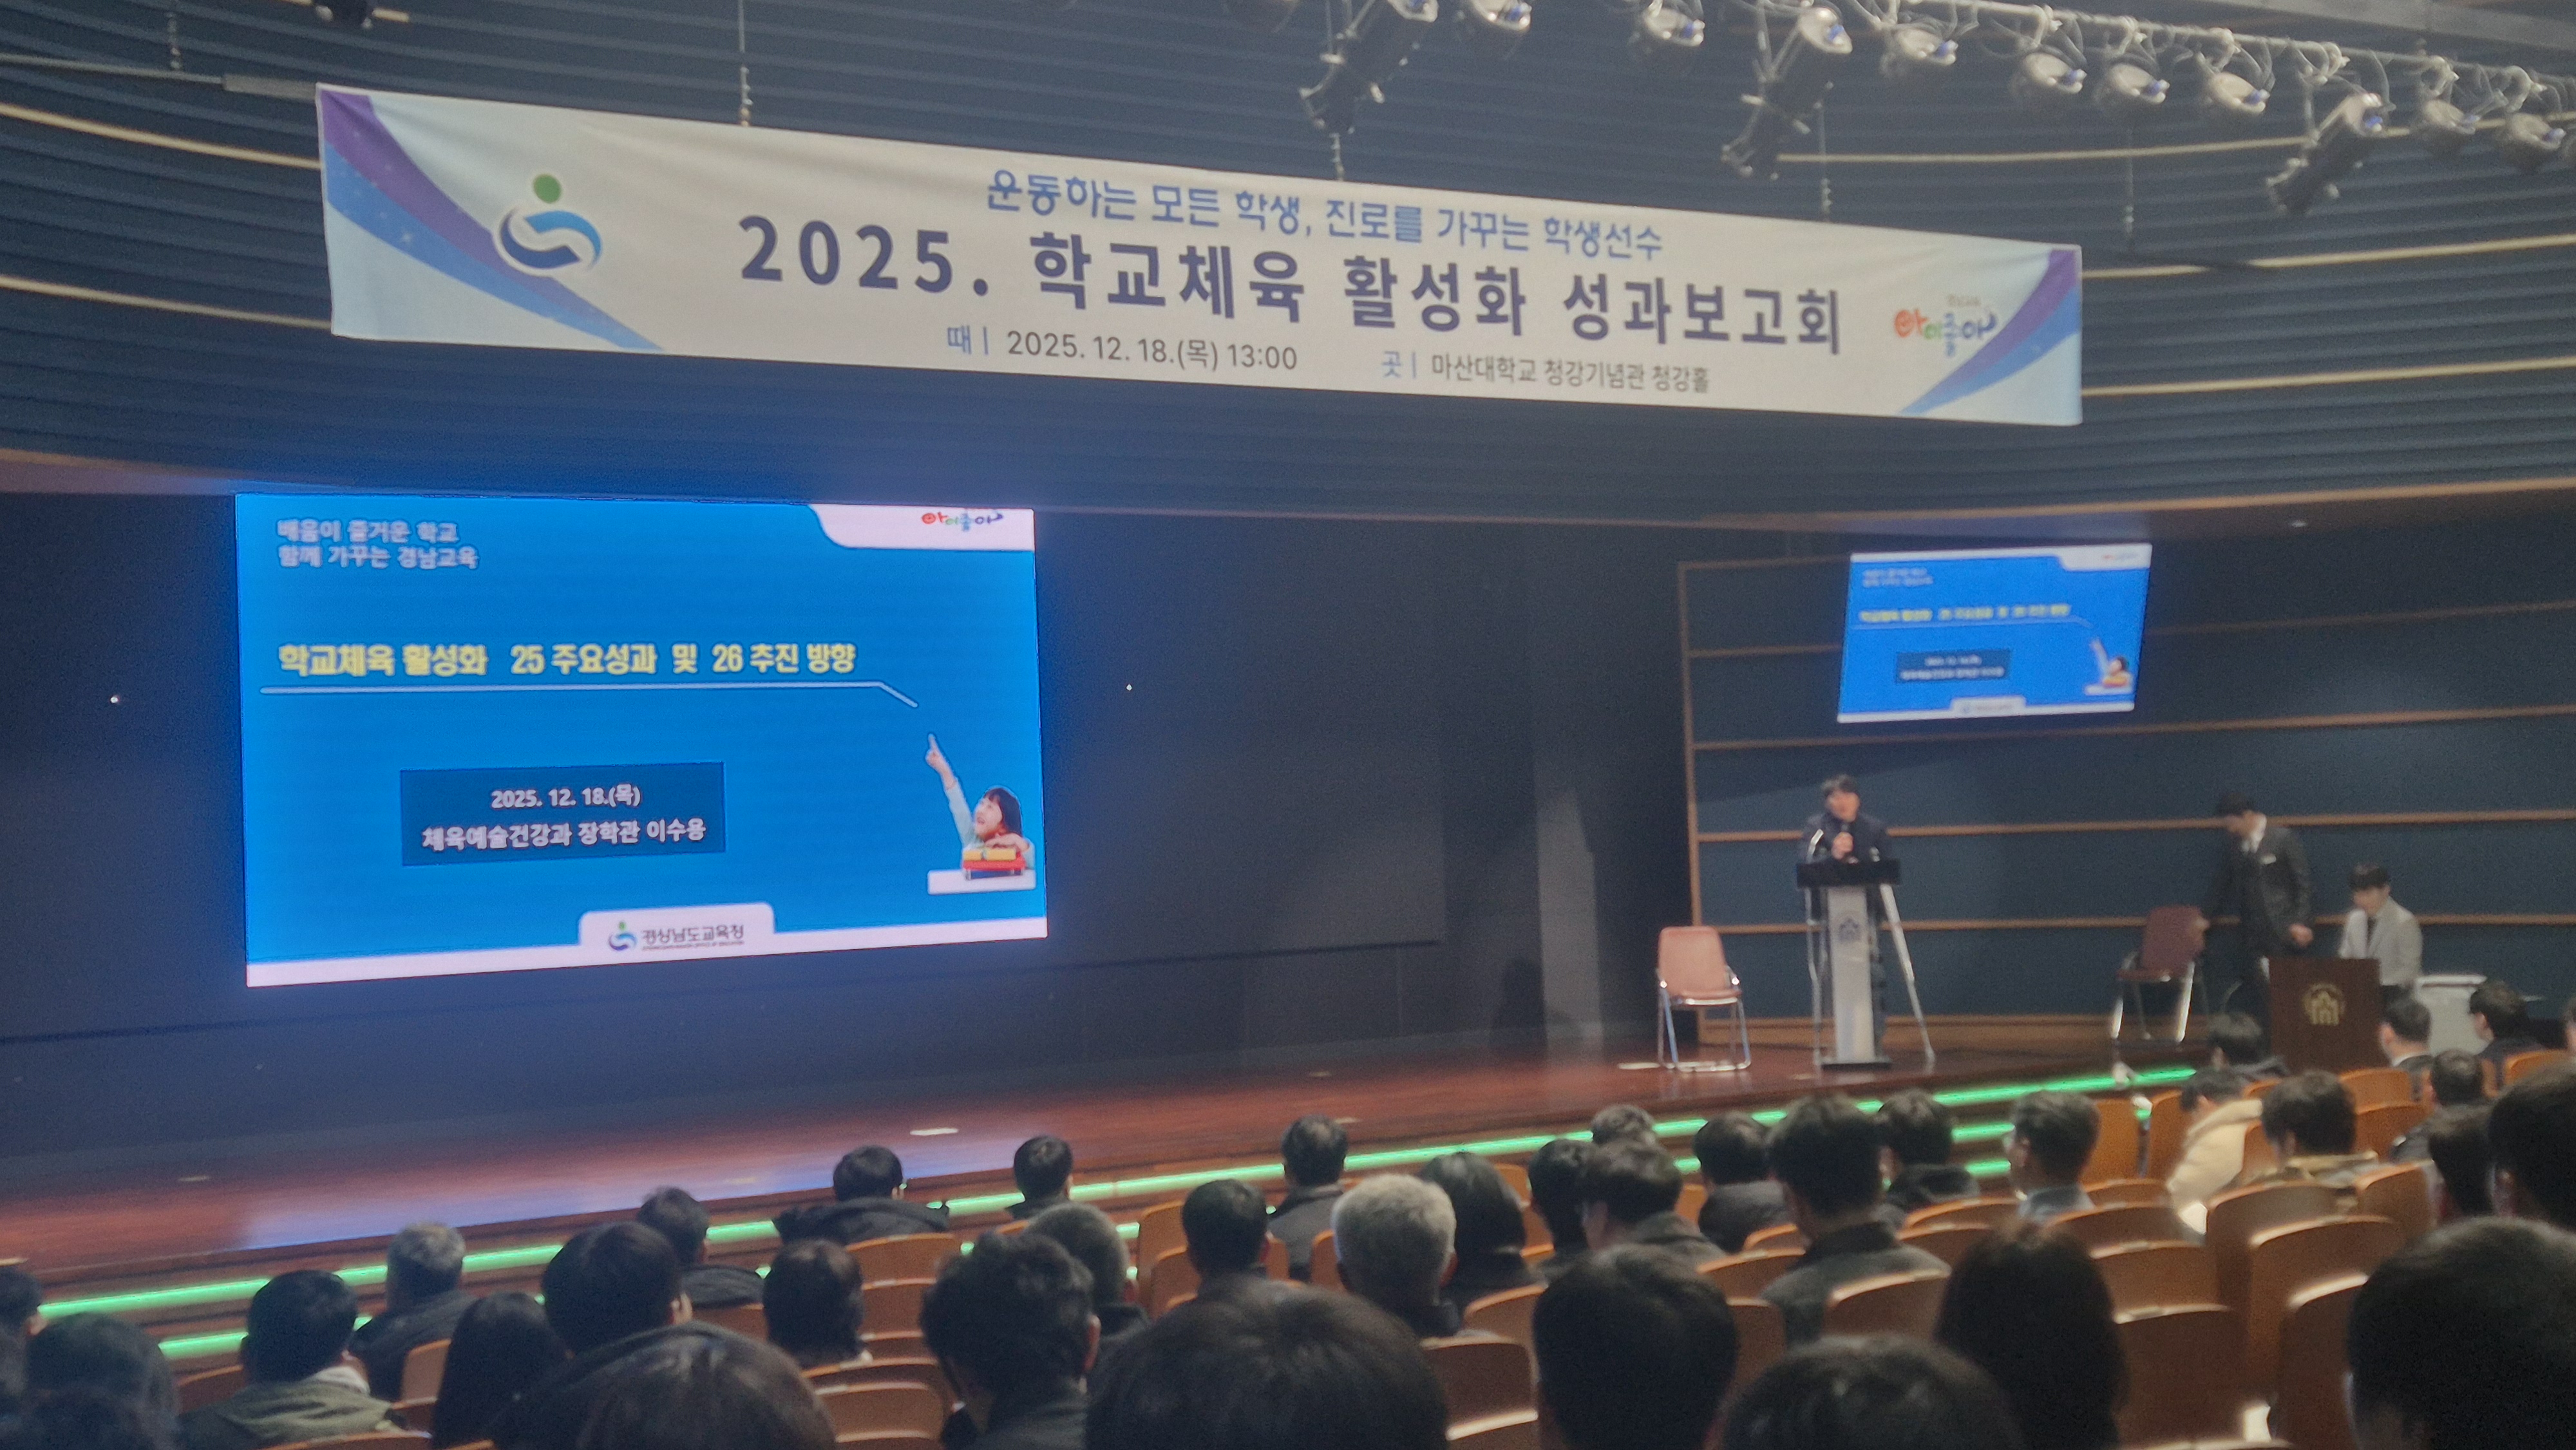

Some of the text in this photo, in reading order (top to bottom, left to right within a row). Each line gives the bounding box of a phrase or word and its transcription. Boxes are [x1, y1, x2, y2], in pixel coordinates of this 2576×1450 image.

[988, 169, 1662, 260] 운동하는 모든 학생, 진로를 가꾸는 학생선수
[739, 215, 1840, 355] 2025. 학교체육 활성화 성과보고회
[1007, 330, 1085, 359] 2025.
[1094, 336, 1130, 361] 12.
[1138, 338, 1218, 372] 18.(목)
[1227, 344, 1298, 370] 13:00
[1432, 353, 1537, 382] 마산대학교
[1545, 359, 1644, 390] 청강기념관
[1653, 365, 1709, 394] 청강홀
[278, 643, 856, 676] 학교체육 활성화 25 주요성과 및 26 추진 방향
[491, 784, 641, 808] 2025. 12. 18.(목)
[422, 818, 706, 851] 체육예술건강과 장학관 이수용
